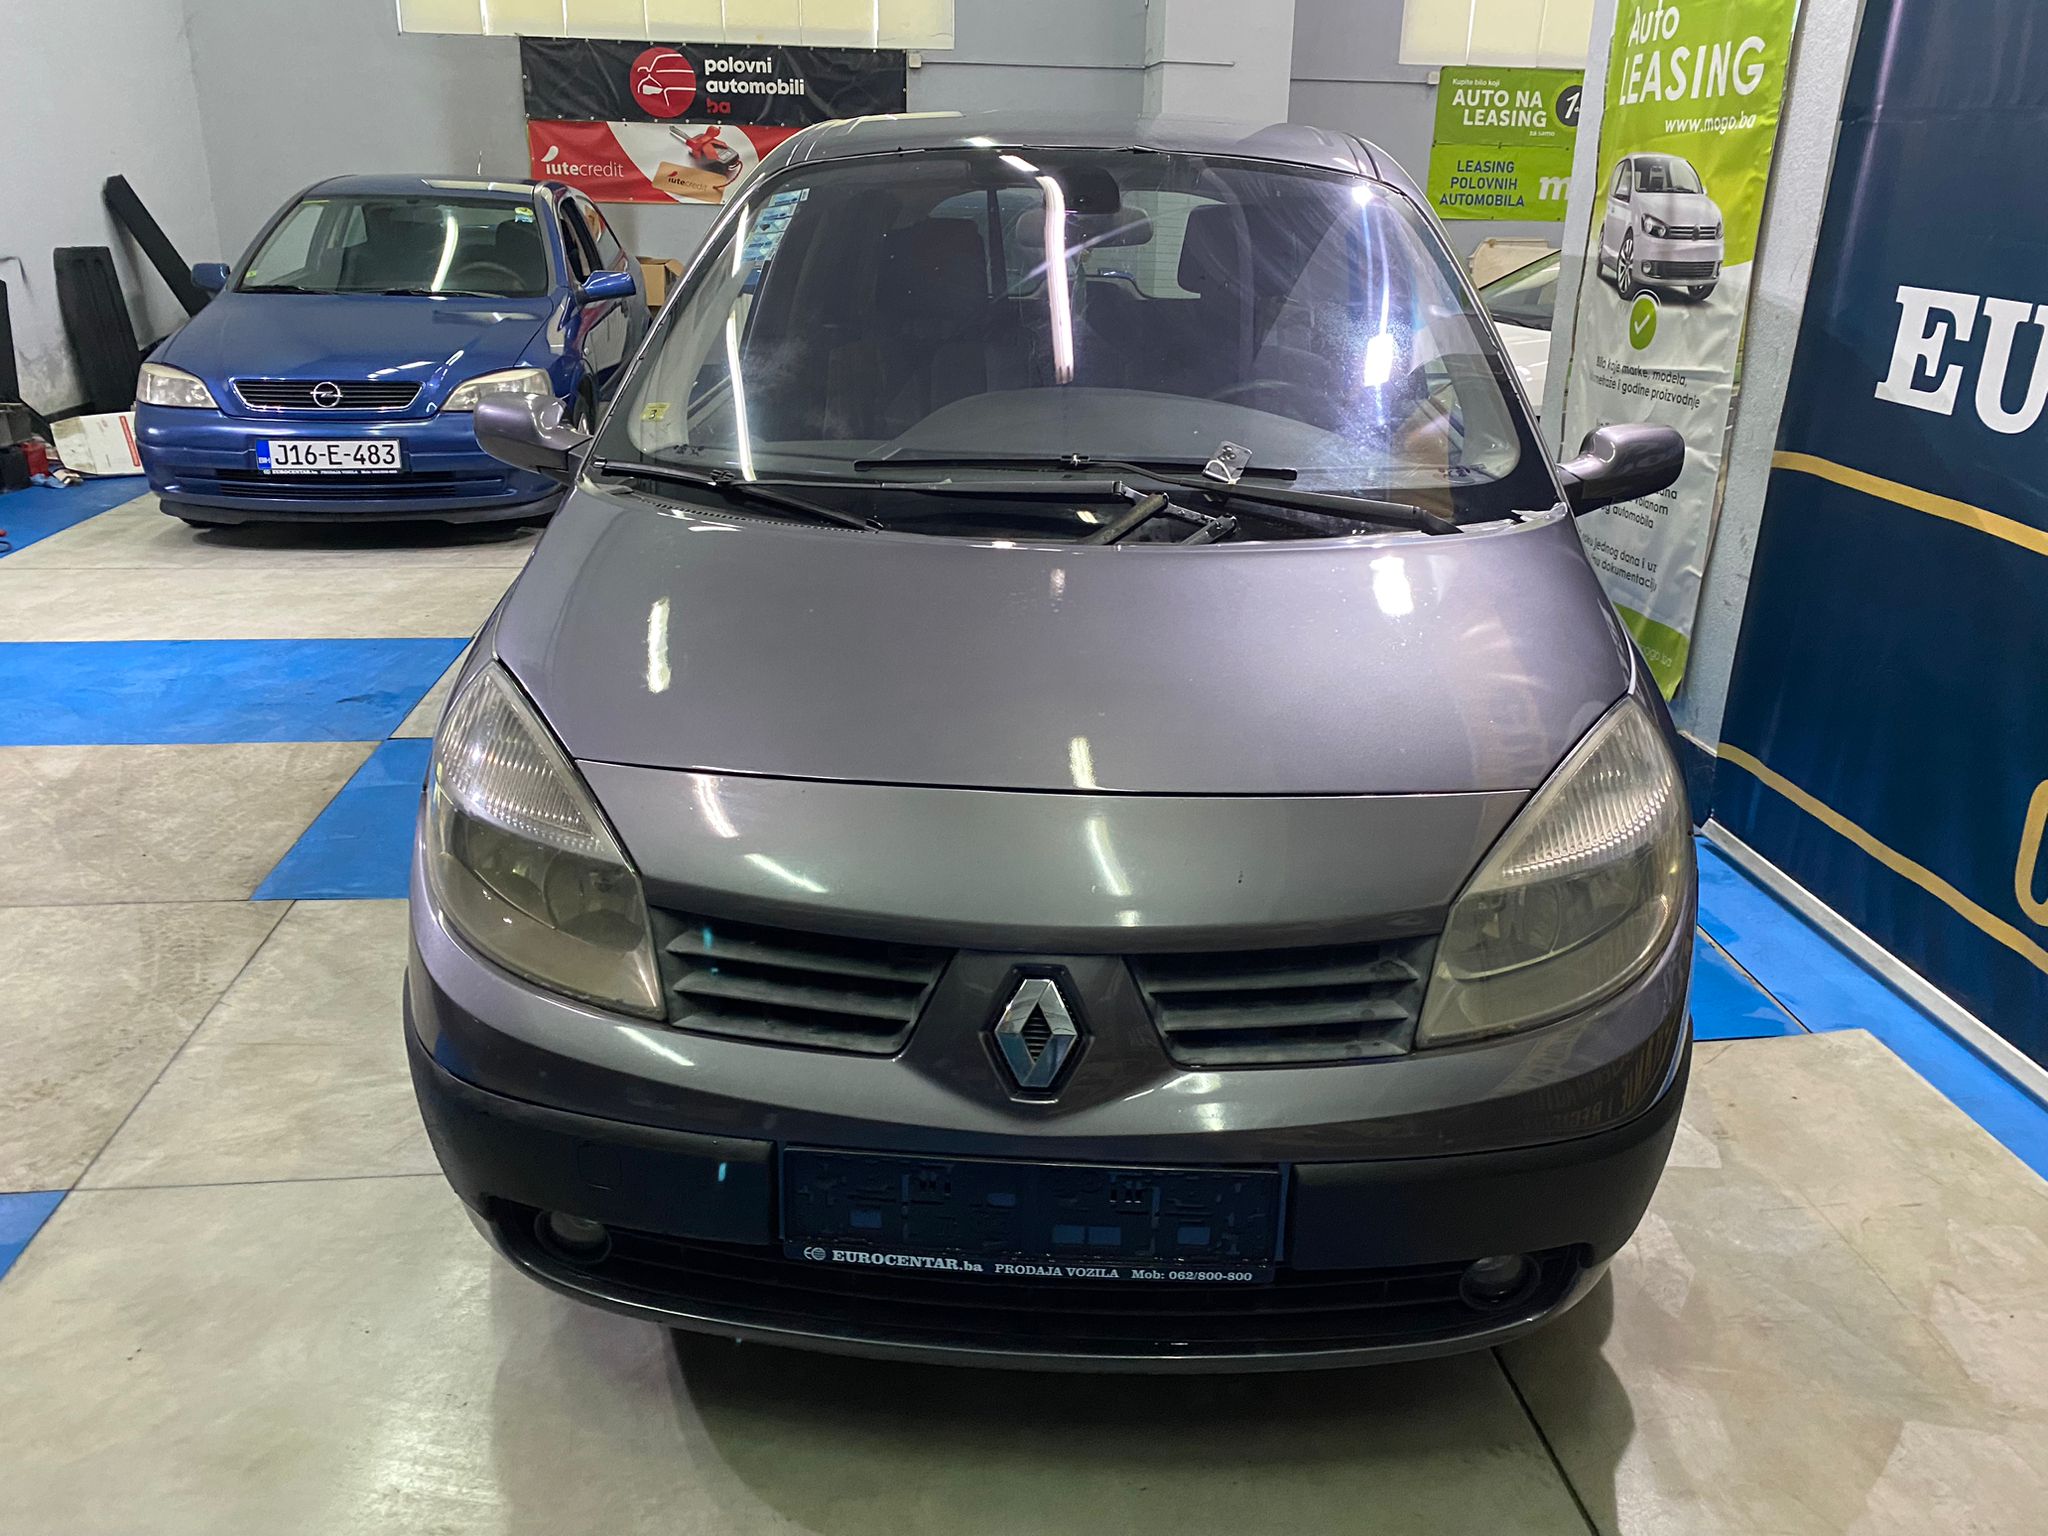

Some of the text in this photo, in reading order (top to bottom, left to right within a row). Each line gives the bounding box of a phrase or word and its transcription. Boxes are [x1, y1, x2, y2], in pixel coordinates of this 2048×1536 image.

[1628, 0, 1680, 47] Auto
[704, 56, 772, 75] polovni
[1619, 36, 1766, 105] LEASING
[705, 78, 805, 95] automobili
[706, 97, 731, 113] ba
[1452, 89, 1543, 107] AUTO NA
[1463, 109, 1547, 128] LEASING
[1665, 111, 1757, 135] www.mogo.ba
[543, 156, 624, 178] iutecredit
[1457, 160, 1514, 173] LEASING
[1450, 177, 1517, 190] POLOVNIH
[1439, 194, 1525, 207] AUTOMOBILA
[1874, 285, 2048, 434] EU
[1652, 370, 1688, 388] modela,
[1621, 382, 1650, 396] godine
[1650, 388, 1700, 410] proizvodnje
[275, 445, 396, 466] J16-E-483
[1613, 505, 1654, 528] automobila
[832, 1250, 1253, 1281] EUROCENTAR.ba PRODAJA VOZILA Mob: 062/800-800
